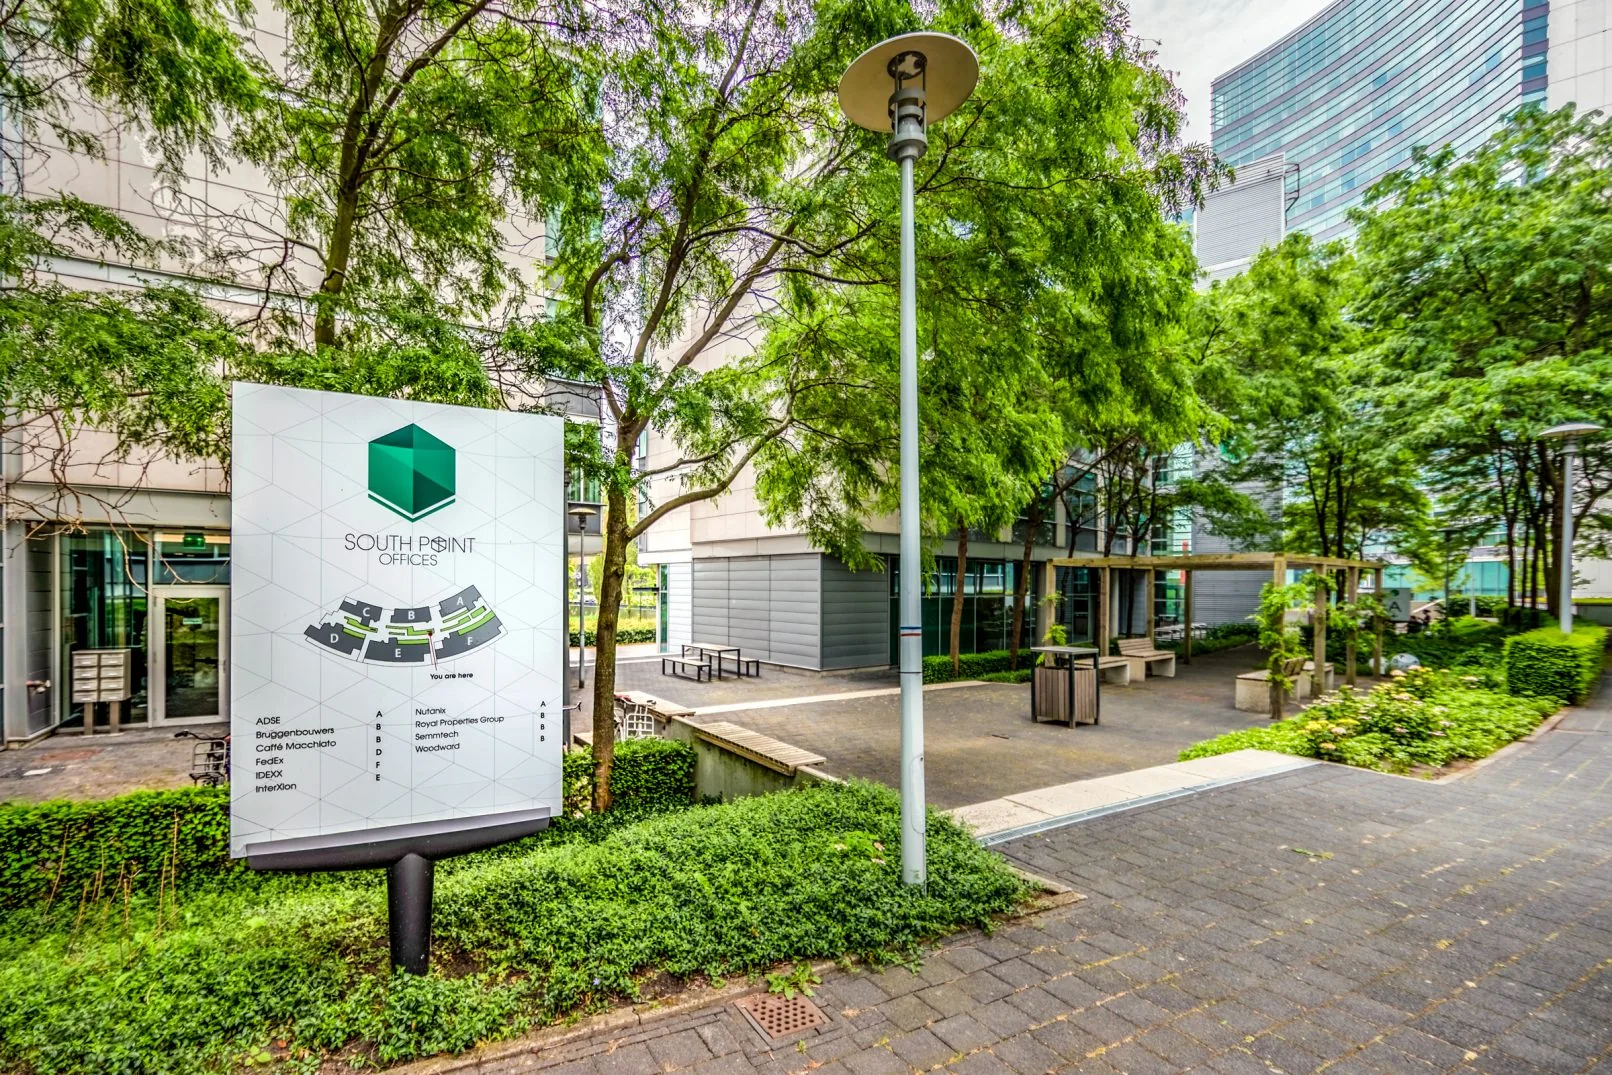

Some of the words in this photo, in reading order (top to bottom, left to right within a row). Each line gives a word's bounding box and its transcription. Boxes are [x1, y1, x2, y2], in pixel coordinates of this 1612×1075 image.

[344, 533, 412, 551] SOUTH
[419, 536, 476, 553] POINT
[378, 552, 438, 567] OFFICES
[456, 596, 464, 605] A
[362, 607, 371, 617] C
[407, 611, 415, 620] B
[330, 634, 339, 643] D
[467, 637, 473, 645] F
[395, 649, 402, 658] E
[430, 673, 443, 681] You
[457, 672, 474, 680] here
[376, 710, 383, 718] A
[415, 707, 447, 716] Nutanix
[255, 716, 281, 726] ADSE
[415, 719, 438, 729] Royal
[440, 716, 479, 727] Properties
[479, 715, 505, 724] Group
[376, 723, 382, 731] B
[540, 723, 546, 731] B
[255, 727, 335, 740] Bruggenbouwers
[415, 731, 459, 741] Semmtech
[255, 743, 283, 753] Caffé
[285, 740, 337, 751] Macchiato
[415, 743, 461, 753] Woodward
[376, 748, 383, 756] D
[255, 757, 284, 766] FedEx
[376, 761, 381, 769] F
[255, 770, 283, 780] IDEXX
[376, 773, 381, 781] E
[255, 783, 297, 793] InterXion
